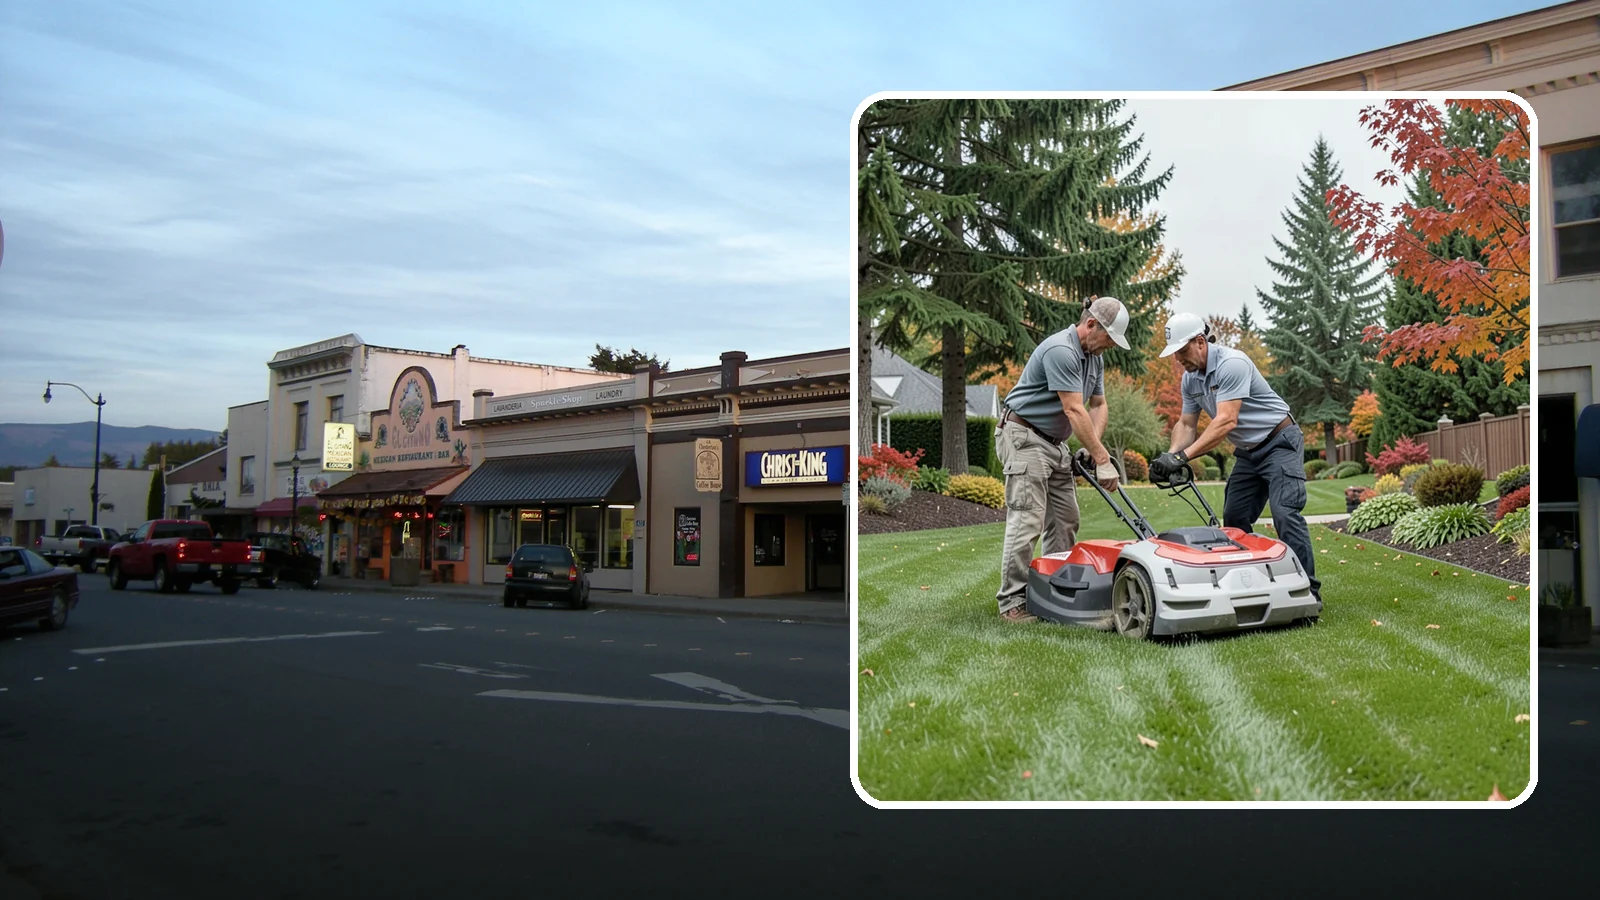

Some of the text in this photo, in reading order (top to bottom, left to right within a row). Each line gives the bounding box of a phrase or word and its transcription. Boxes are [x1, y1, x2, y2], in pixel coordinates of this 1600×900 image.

[493, 402, 522, 413] LAVANDERIA
[595, 389, 623, 400] LAUNDRY
[374, 450, 450, 464] MEXICAN RESTAURANT BAR
[761, 450, 827, 478] CHRIST KING
